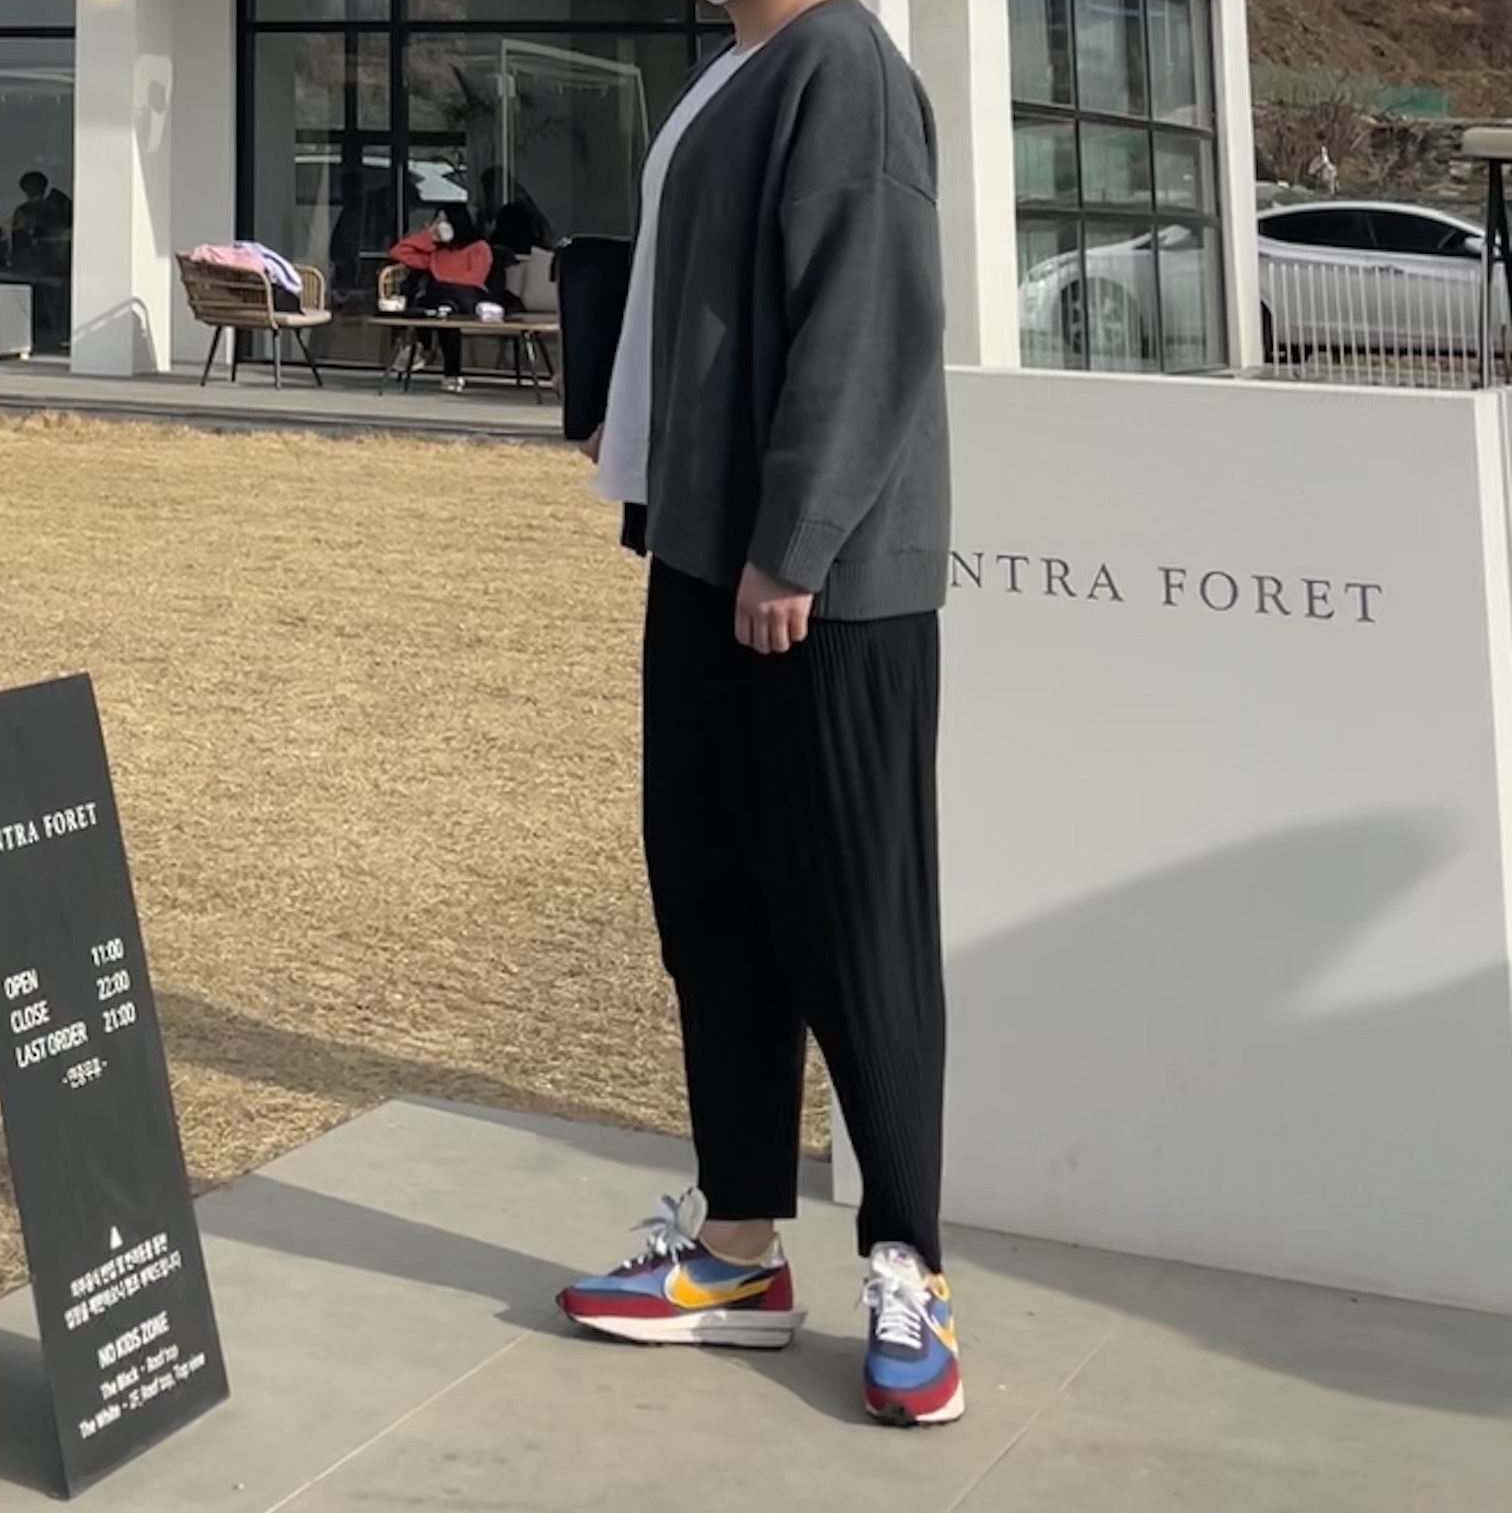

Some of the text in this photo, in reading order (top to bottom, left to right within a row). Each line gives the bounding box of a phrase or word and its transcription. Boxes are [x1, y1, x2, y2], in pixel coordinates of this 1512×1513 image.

[948, 551, 1383, 624] NTRA FORET
[42, 802, 97, 839] FORET
[3, 937, 124, 1000] OPEN 11:00
[10, 969, 131, 1034] CLOSE 22:00
[15, 1001, 137, 1068] LAST ORDER 21:00
[98, 1310, 170, 1370] NO KIDS ZONE
